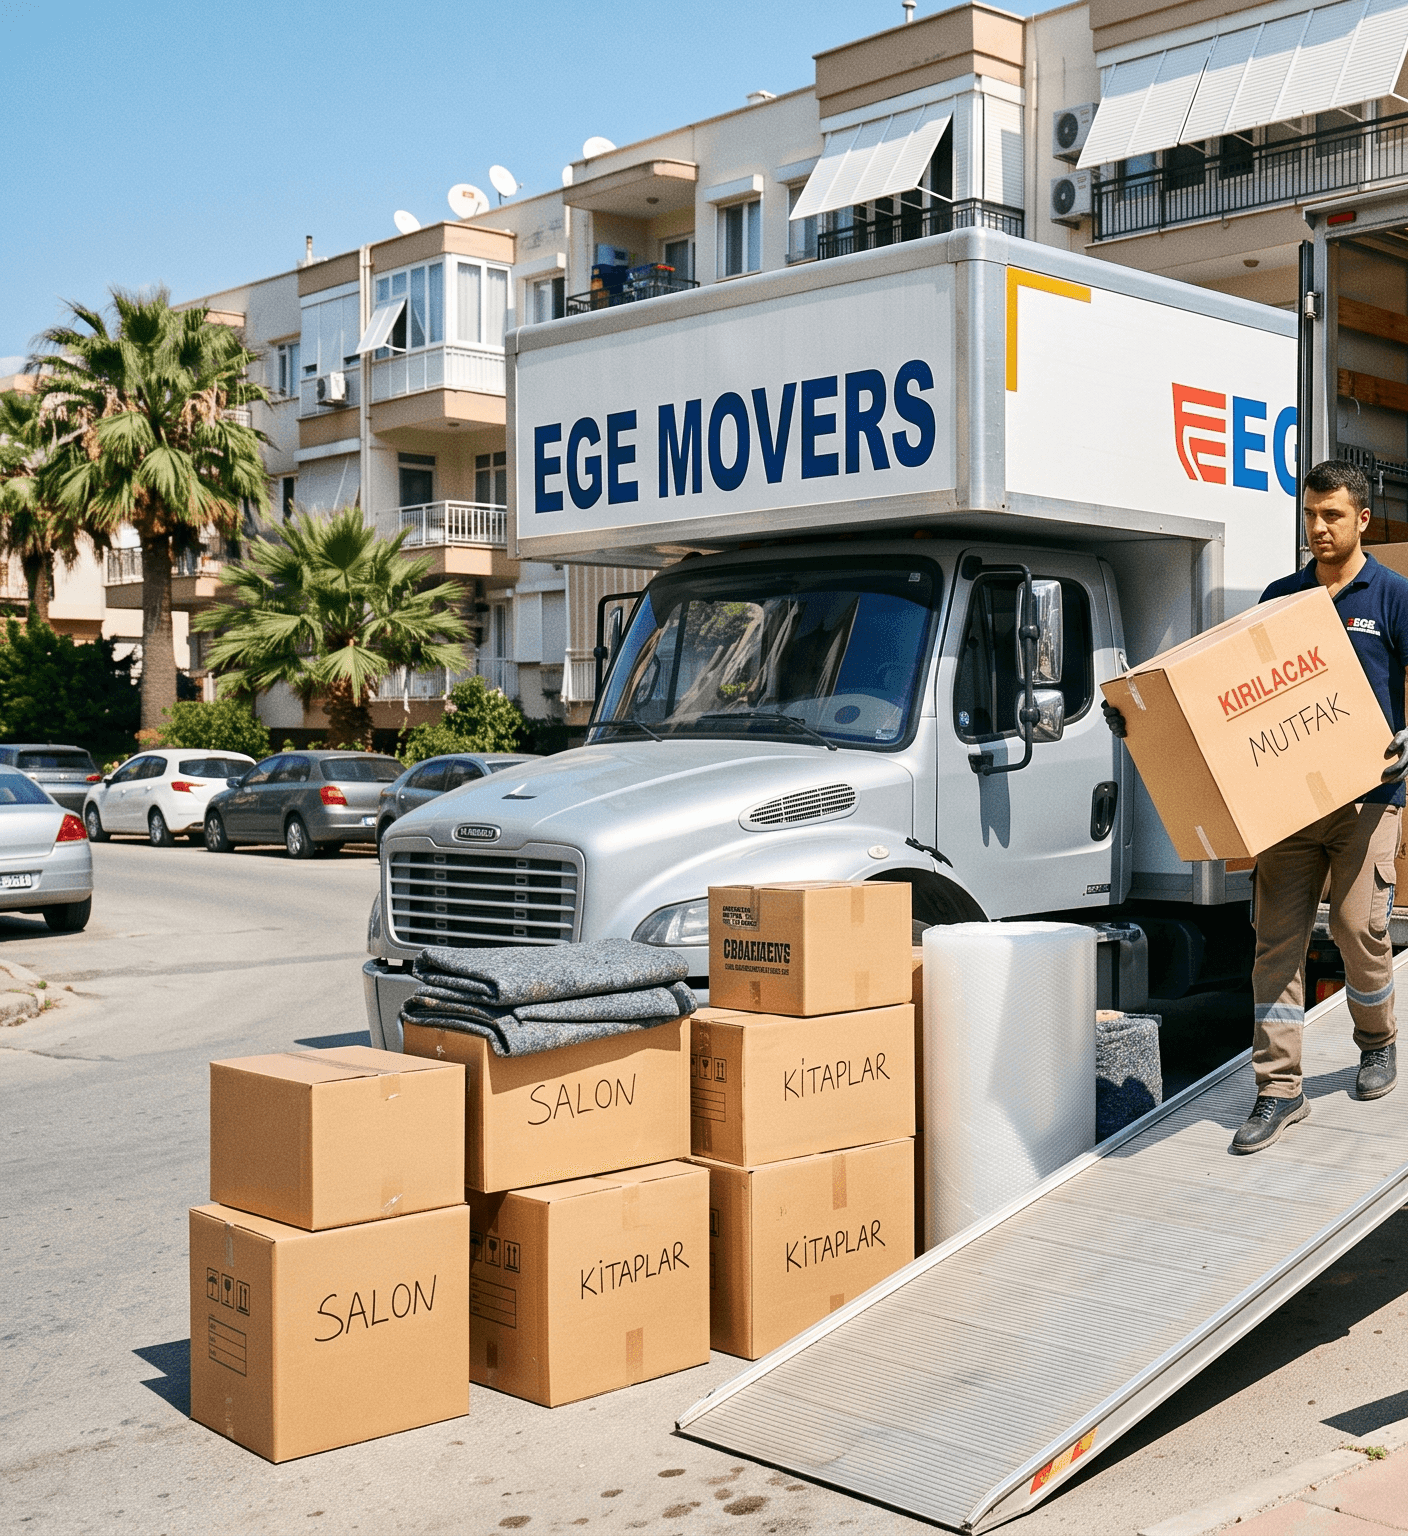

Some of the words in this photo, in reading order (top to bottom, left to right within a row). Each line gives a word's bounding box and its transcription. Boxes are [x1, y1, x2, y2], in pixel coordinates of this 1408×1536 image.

[534, 410, 639, 513] EGE
[658, 359, 937, 499] MOVERS
[1217, 646, 1327, 717] KIRILACAK
[1248, 692, 1350, 767] MUTFAK
[527, 1072, 637, 1127] SALON
[782, 1051, 892, 1102] KİTAPLAR
[579, 1240, 690, 1300] KİTAPLAR
[785, 1219, 887, 1273] KİTAPLAR
[314, 1274, 438, 1343] SALON
